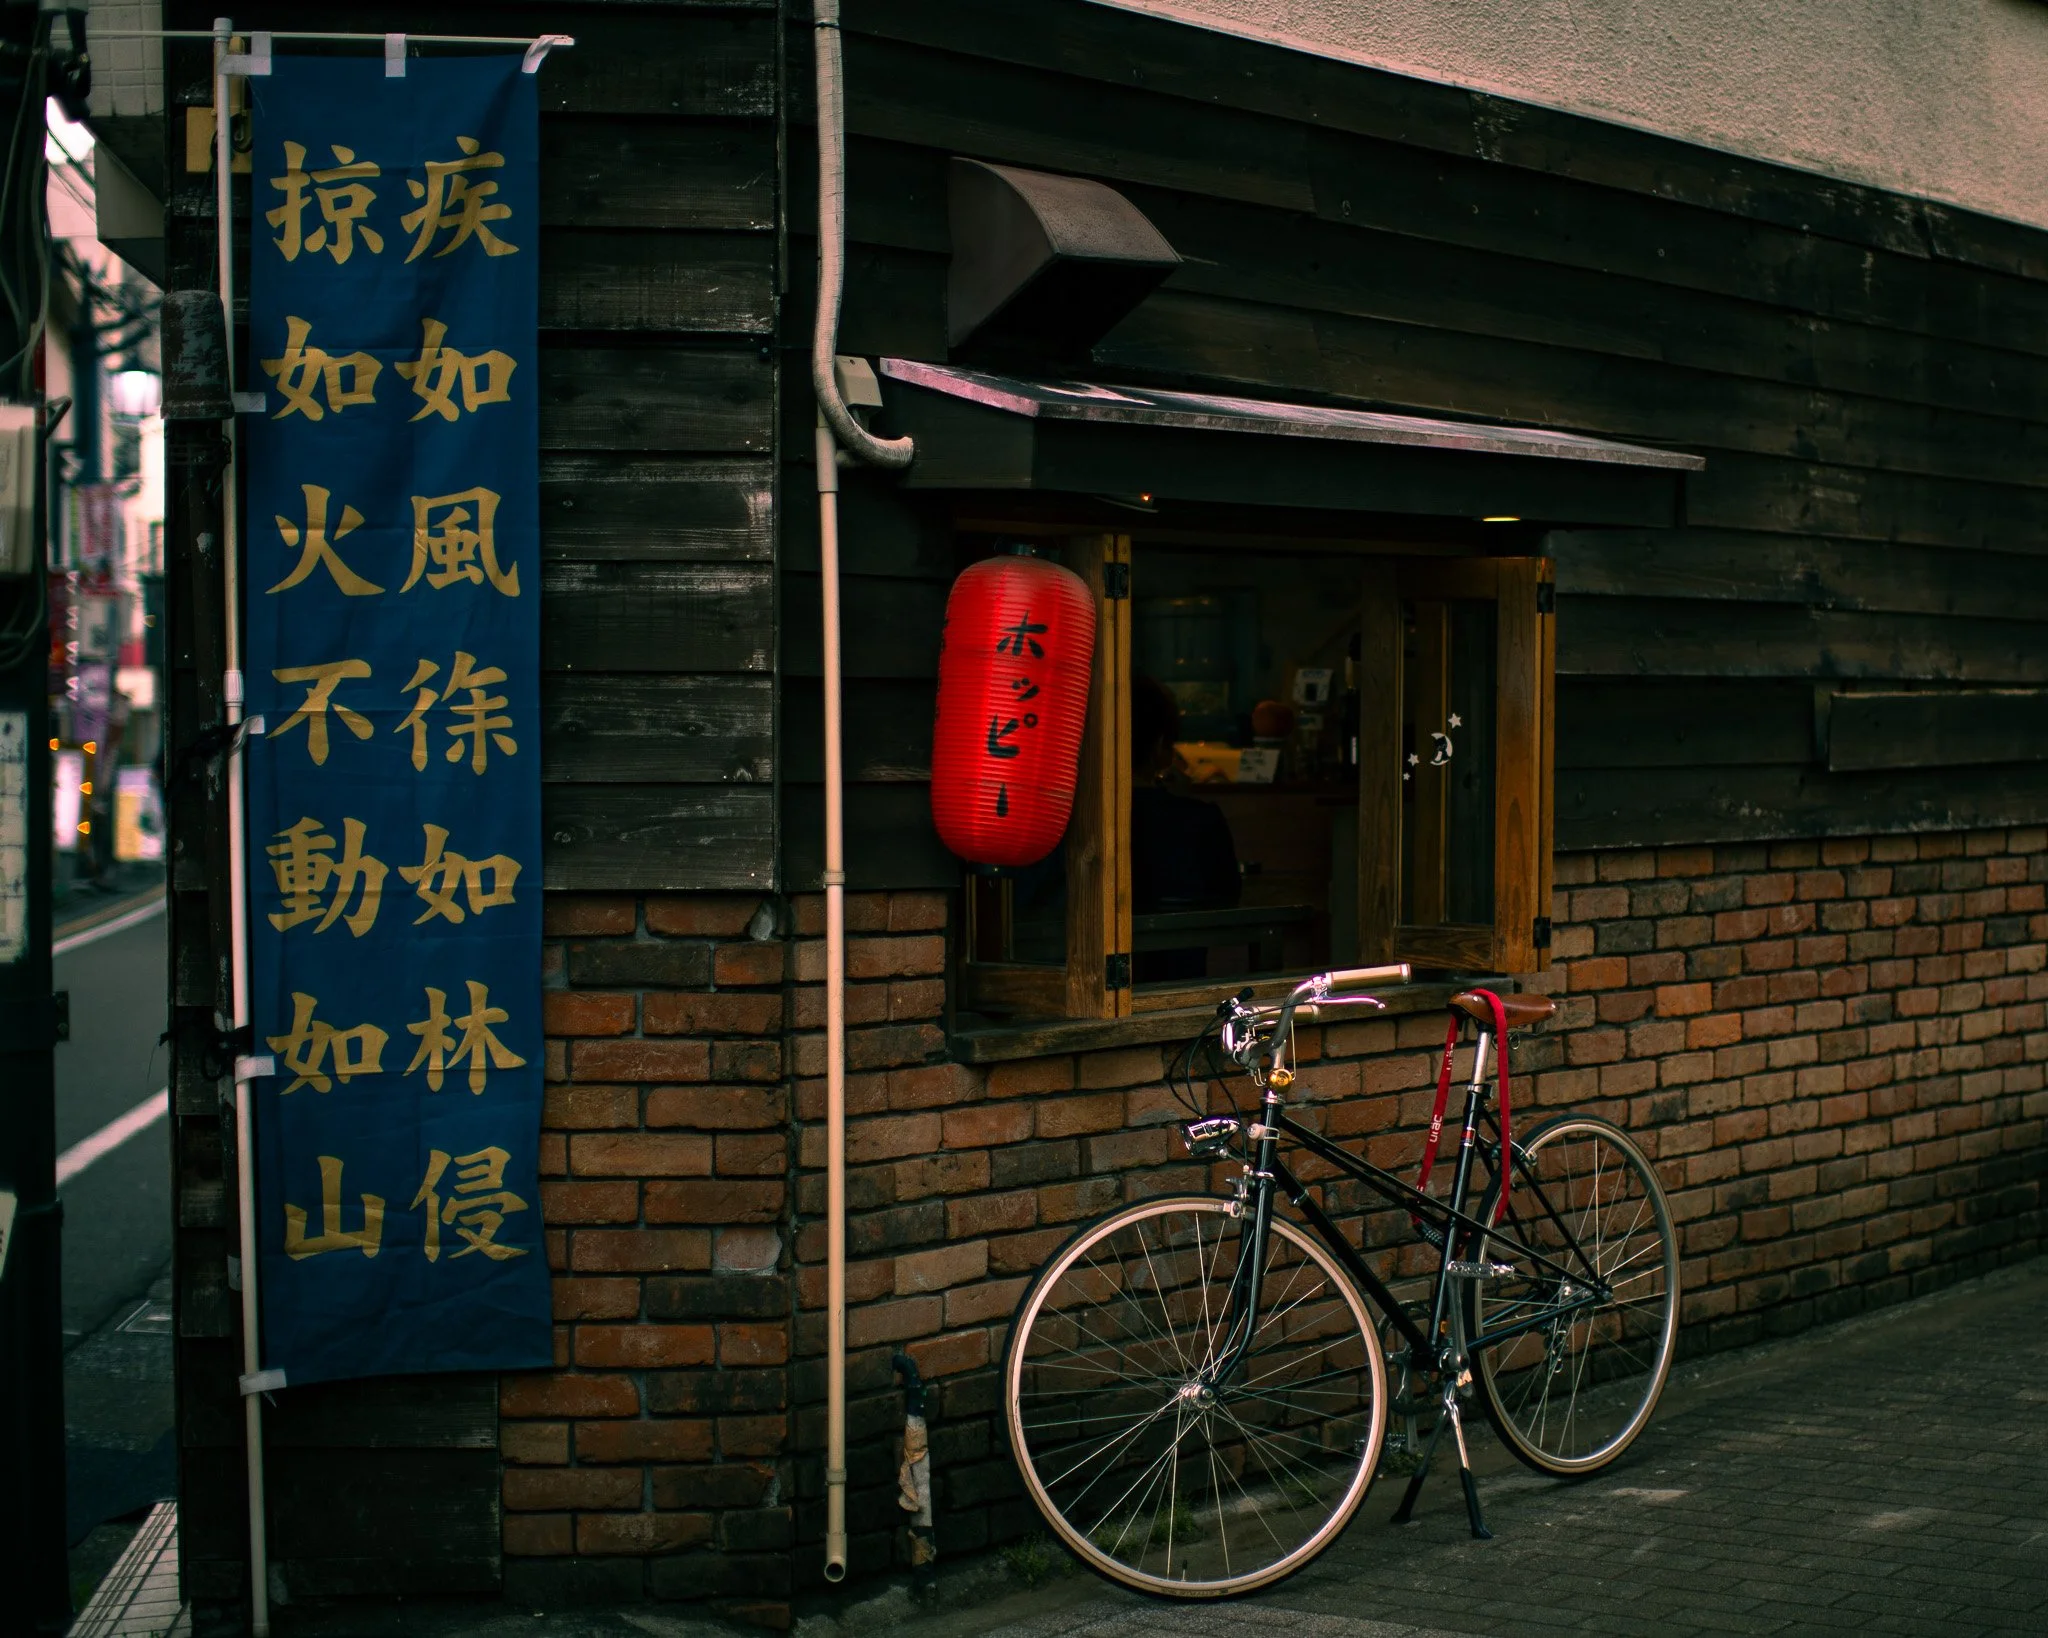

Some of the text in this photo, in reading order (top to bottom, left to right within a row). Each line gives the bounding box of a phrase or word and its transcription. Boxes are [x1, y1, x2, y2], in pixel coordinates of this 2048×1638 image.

[261, 140, 390, 1261] 掠如火不動如山
[394, 136, 529, 1263] 疾如風徐如林侵
[987, 610, 1048, 817] ホッピー
